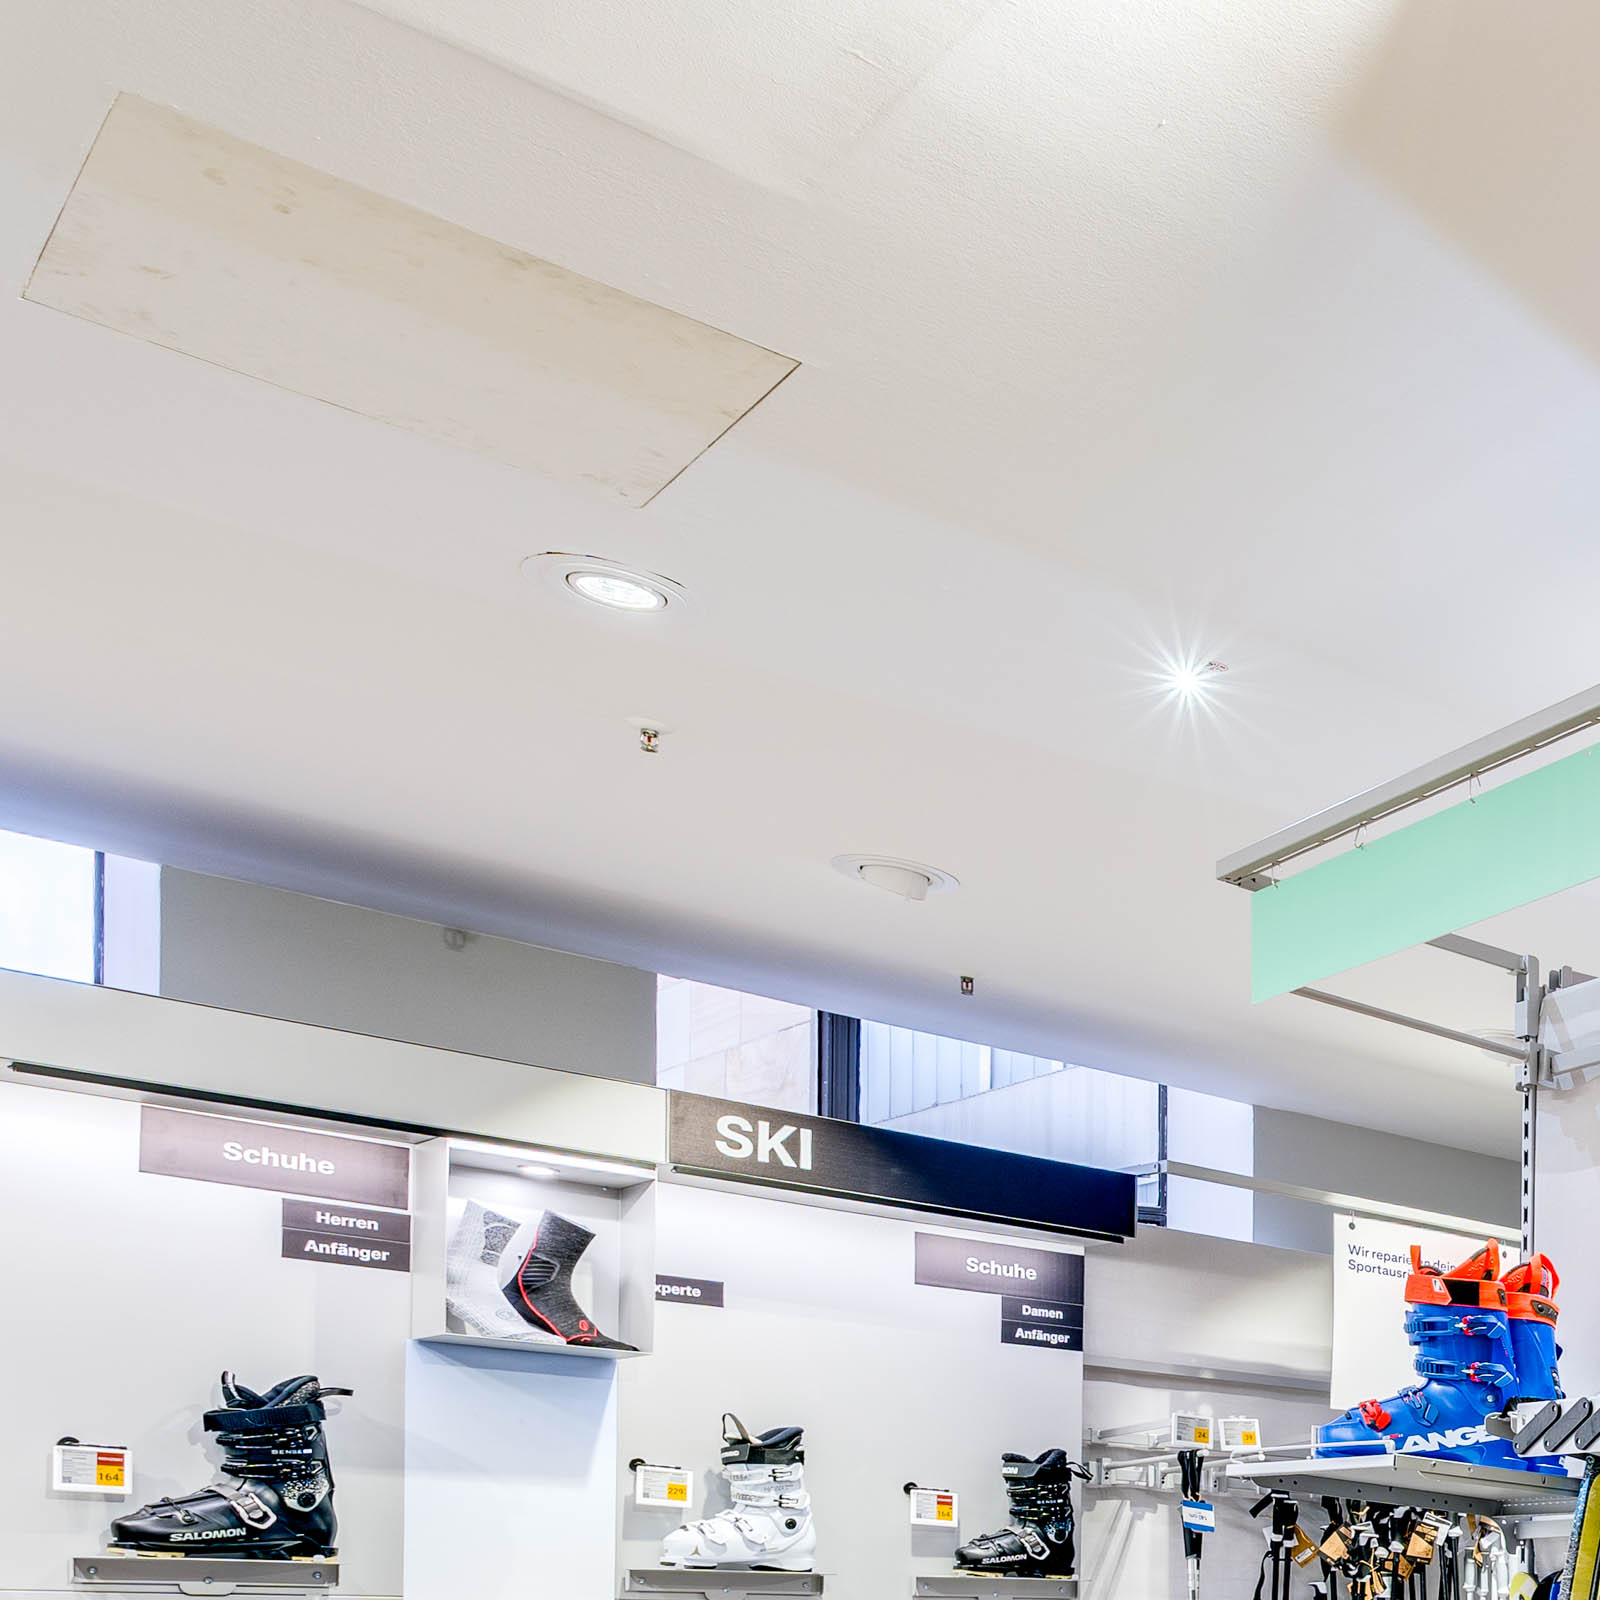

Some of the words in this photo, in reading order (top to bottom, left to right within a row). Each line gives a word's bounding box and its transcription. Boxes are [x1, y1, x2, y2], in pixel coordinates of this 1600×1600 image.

[714, 1114, 813, 1170] SKI
[222, 1140, 335, 1176] Schuhe
[315, 1210, 379, 1232] Herren
[304, 1238, 390, 1264] Anfänger
[1348, 1244, 1368, 1258] Wir
[1372, 1250, 1431, 1268] reparien
[966, 1256, 1037, 1281] Schuhe
[656, 1281, 701, 1299] xperte
[1022, 1304, 1064, 1321] Damen
[1015, 1327, 1070, 1346] Anfänger
[1400, 1425, 1502, 1453] ANGE
[170, 1527, 247, 1542] SALOMON
[981, 1553, 1028, 1565] SALOMON
